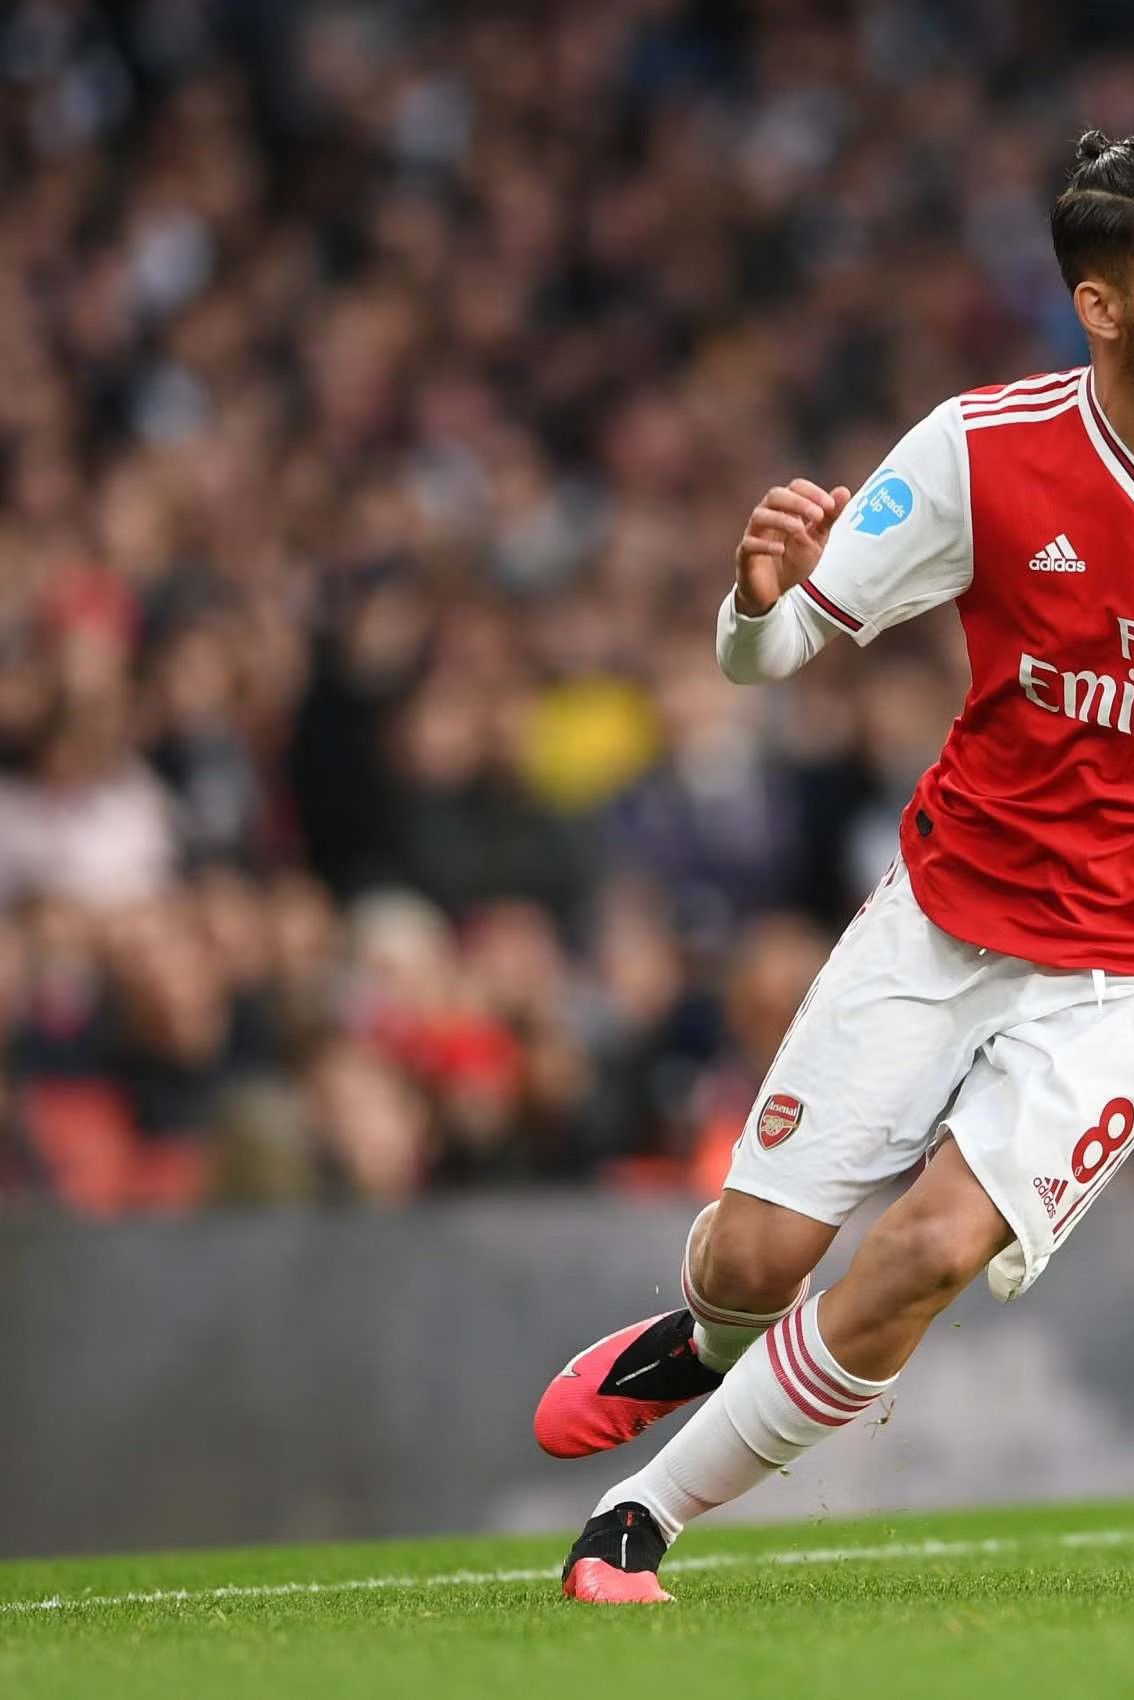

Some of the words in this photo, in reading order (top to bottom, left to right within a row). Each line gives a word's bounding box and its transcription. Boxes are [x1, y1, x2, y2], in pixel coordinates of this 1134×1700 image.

[869, 496, 883, 513] Up
[879, 487, 906, 518] Heads
[1029, 556, 1086, 573] adidas
[769, 1101, 797, 1117] Arsenal
[1071, 1097, 1134, 1184] 8
[1033, 1177, 1056, 1219] adidas
